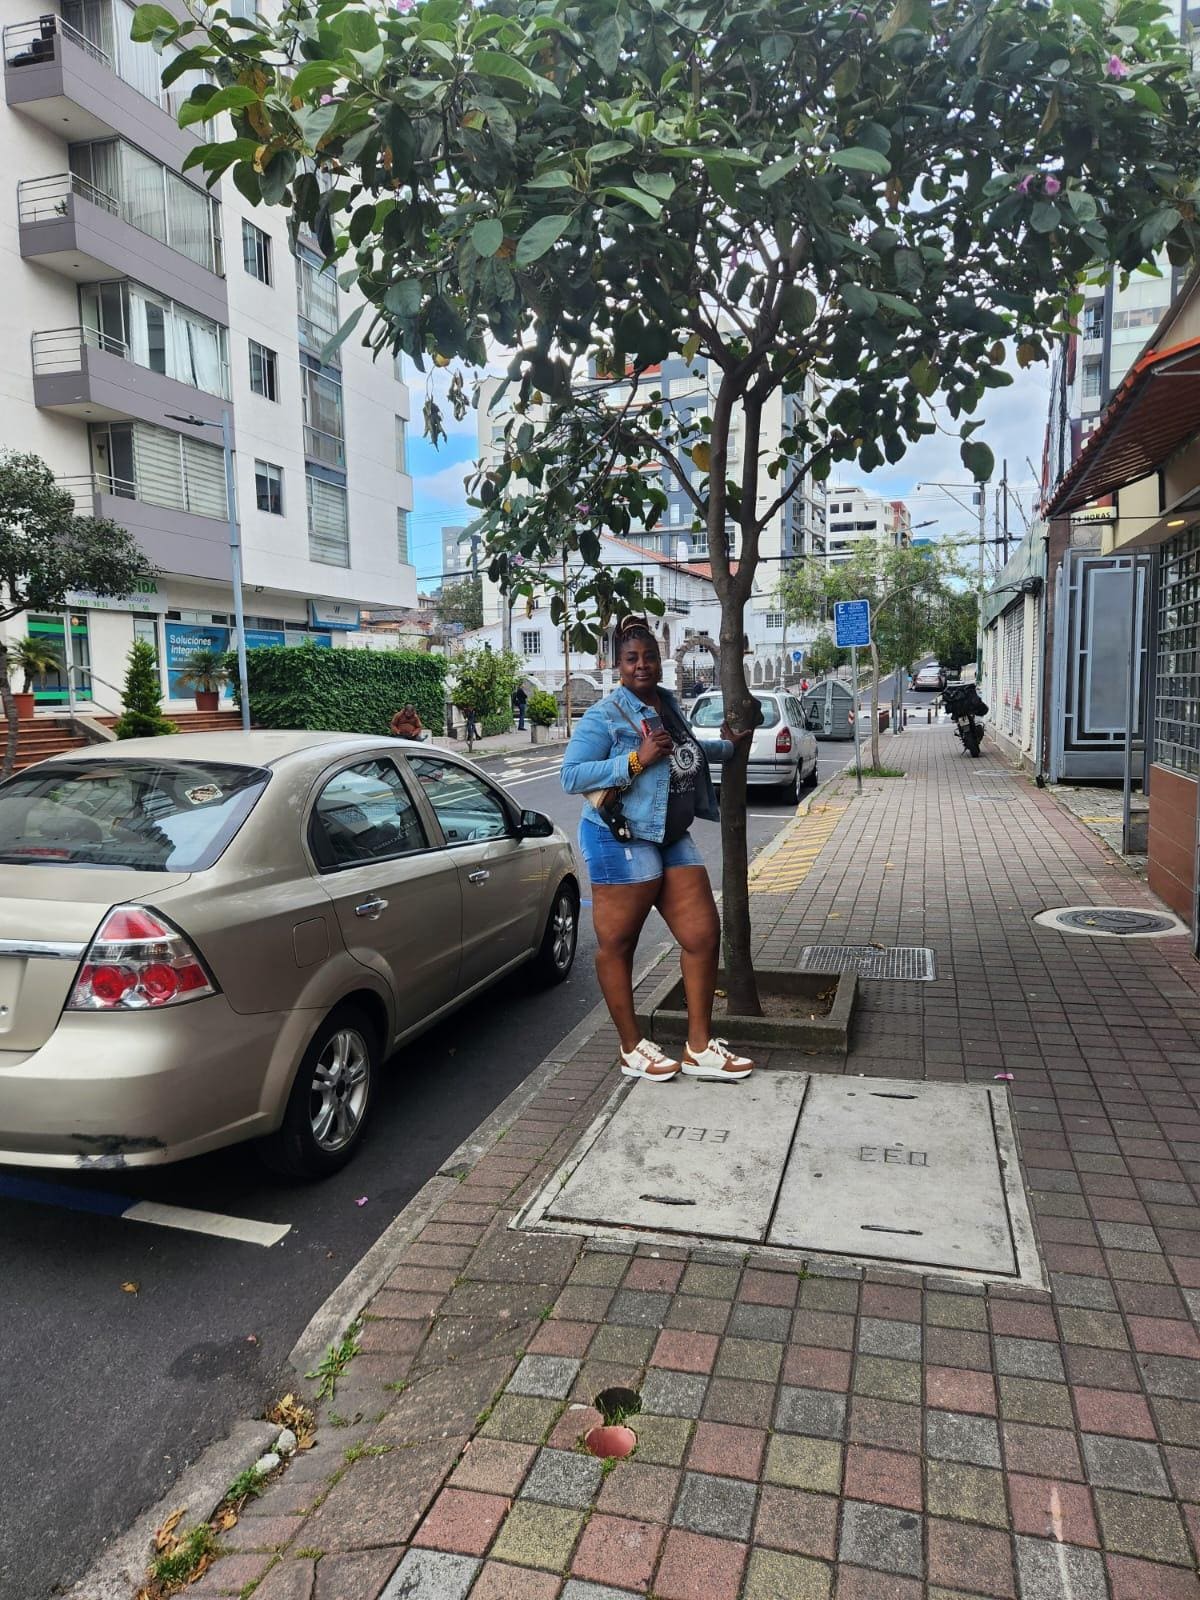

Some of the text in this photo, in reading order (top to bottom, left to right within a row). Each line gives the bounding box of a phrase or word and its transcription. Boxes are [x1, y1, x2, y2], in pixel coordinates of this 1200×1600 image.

[1085, 512, 1110, 521] HORAS
[838, 604, 846, 614] E
[170, 634, 212, 646] Soluciones
